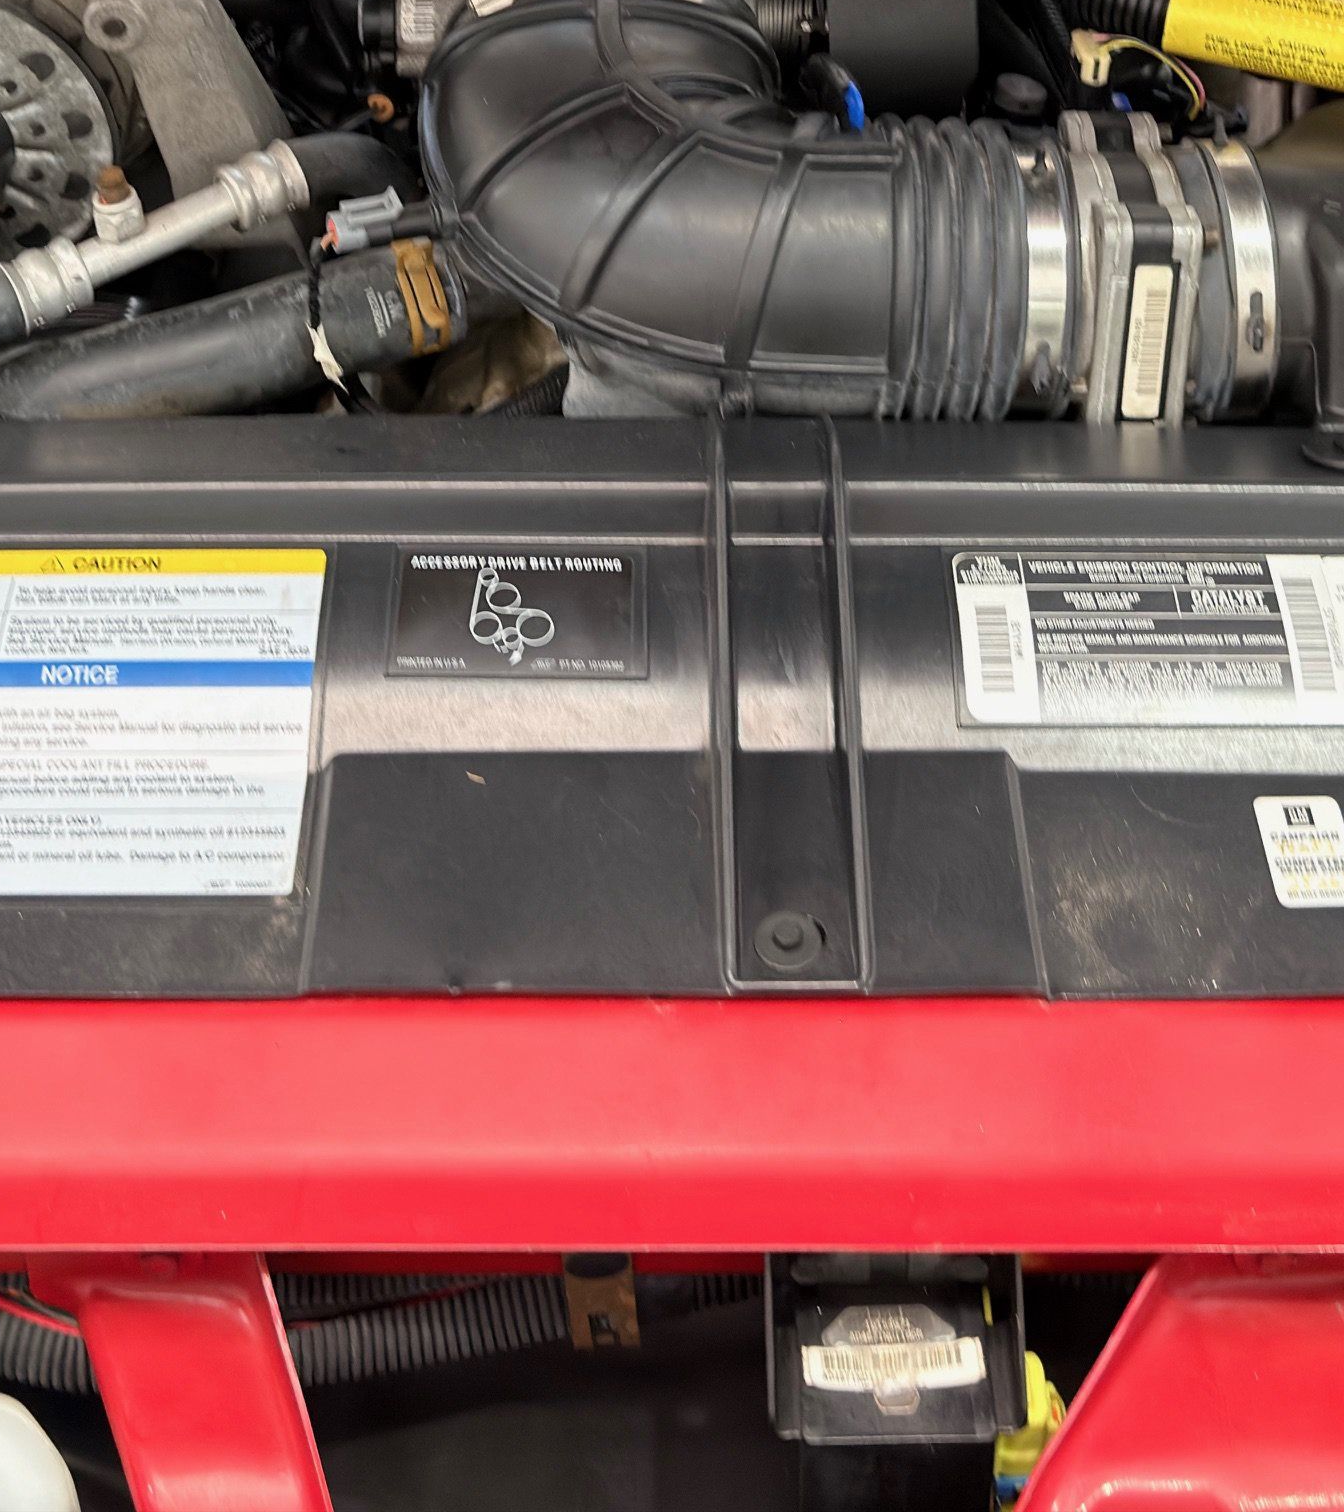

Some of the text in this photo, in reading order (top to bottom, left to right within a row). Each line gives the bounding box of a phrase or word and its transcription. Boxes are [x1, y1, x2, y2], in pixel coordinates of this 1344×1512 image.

[73, 556, 162, 573] CAUTION
[410, 555, 623, 572] ACCESSORY DRIVE BELT ROUTING
[1028, 561, 1075, 574] VEHICLE
[1077, 561, 1130, 575] EMISSION
[1132, 561, 1186, 575] CONTROL
[1186, 562, 1263, 576] INFORMATION
[1191, 590, 1265, 607] CATALYST
[41, 664, 119, 685] NOTICE
[1270, 831, 1340, 842] CAMPAIGN
